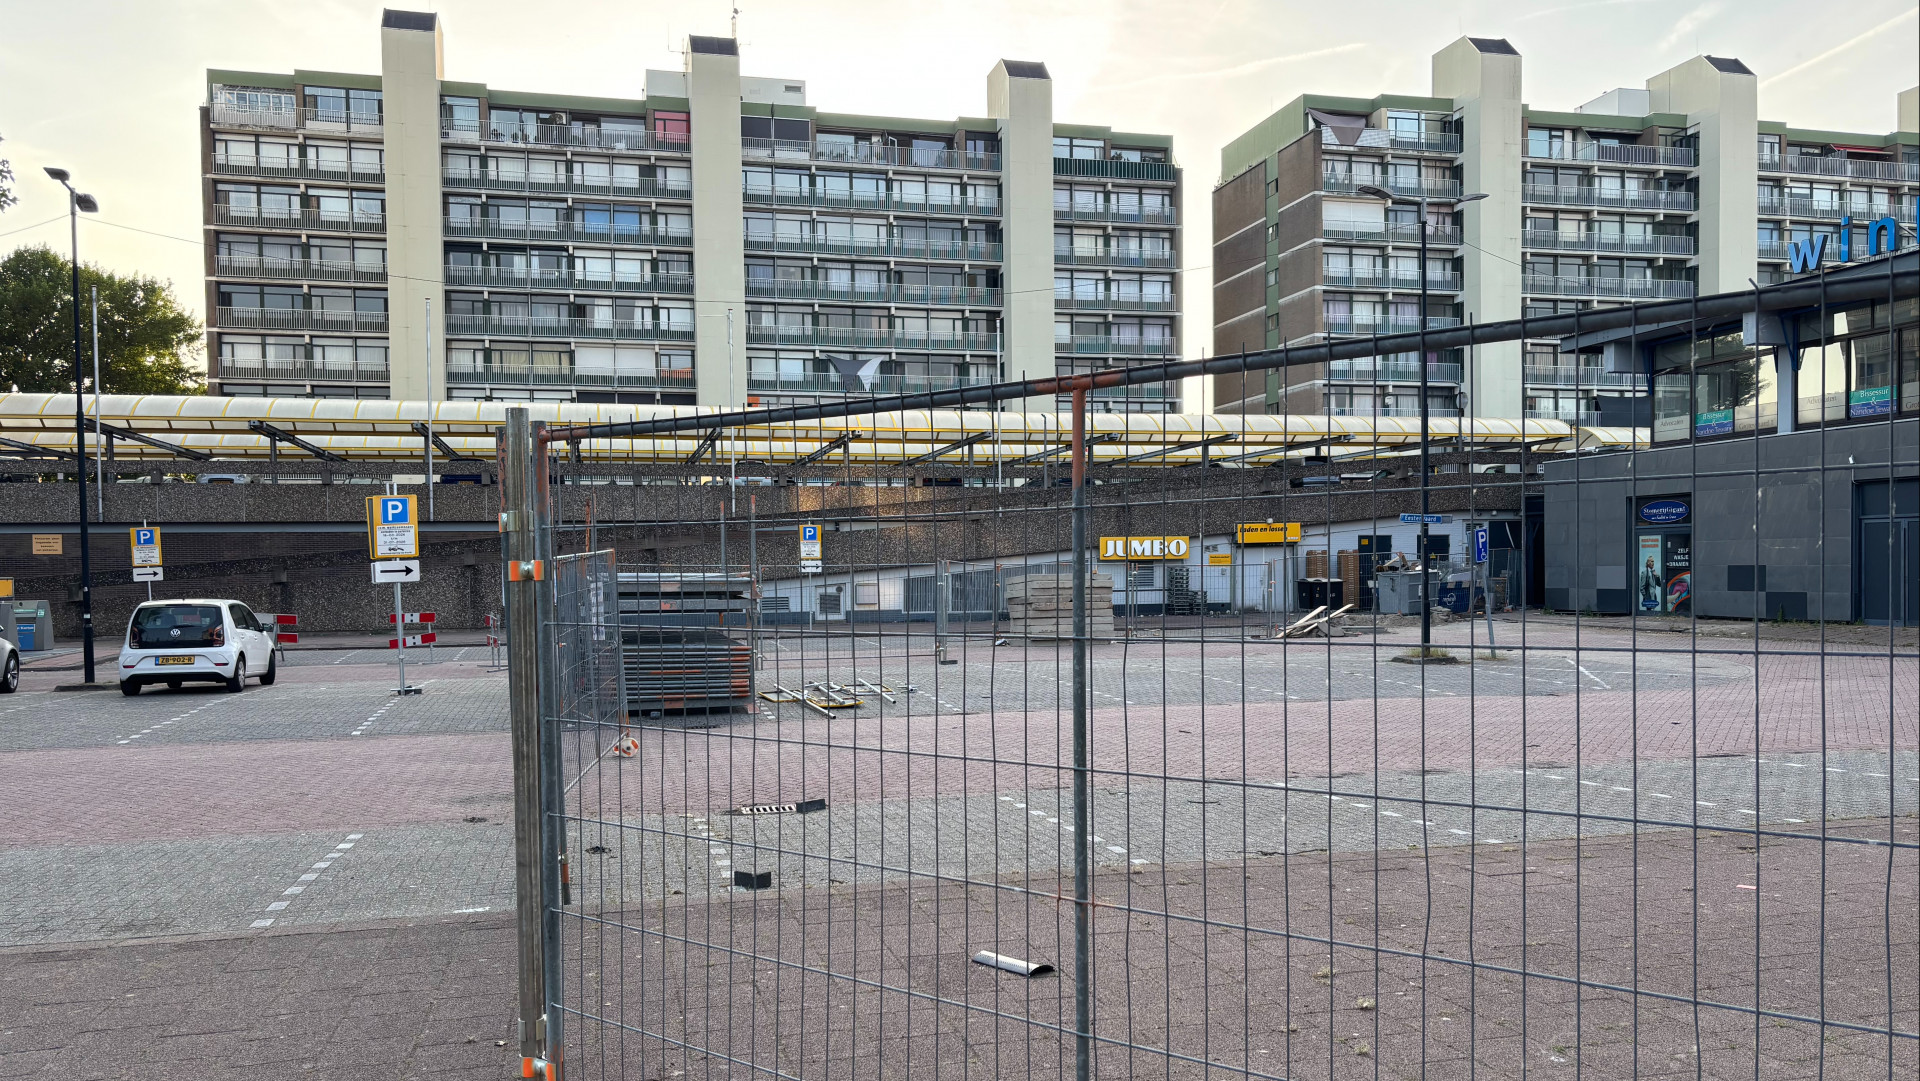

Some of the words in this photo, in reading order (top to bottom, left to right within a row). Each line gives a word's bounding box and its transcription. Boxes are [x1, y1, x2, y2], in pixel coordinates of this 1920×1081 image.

[1860, 389, 1888, 398] Bissessur
[1807, 396, 1837, 404] Advoaten
[1871, 397, 1877, 406] &
[1850, 407, 1875, 416] Nandoe
[388, 500, 403, 521] P
[1404, 514, 1437, 522] Eesteraard
[140, 531, 151, 544] P
[806, 528, 814, 540] P
[1478, 531, 1486, 549] P
[1103, 539, 1187, 557] JUMBO
